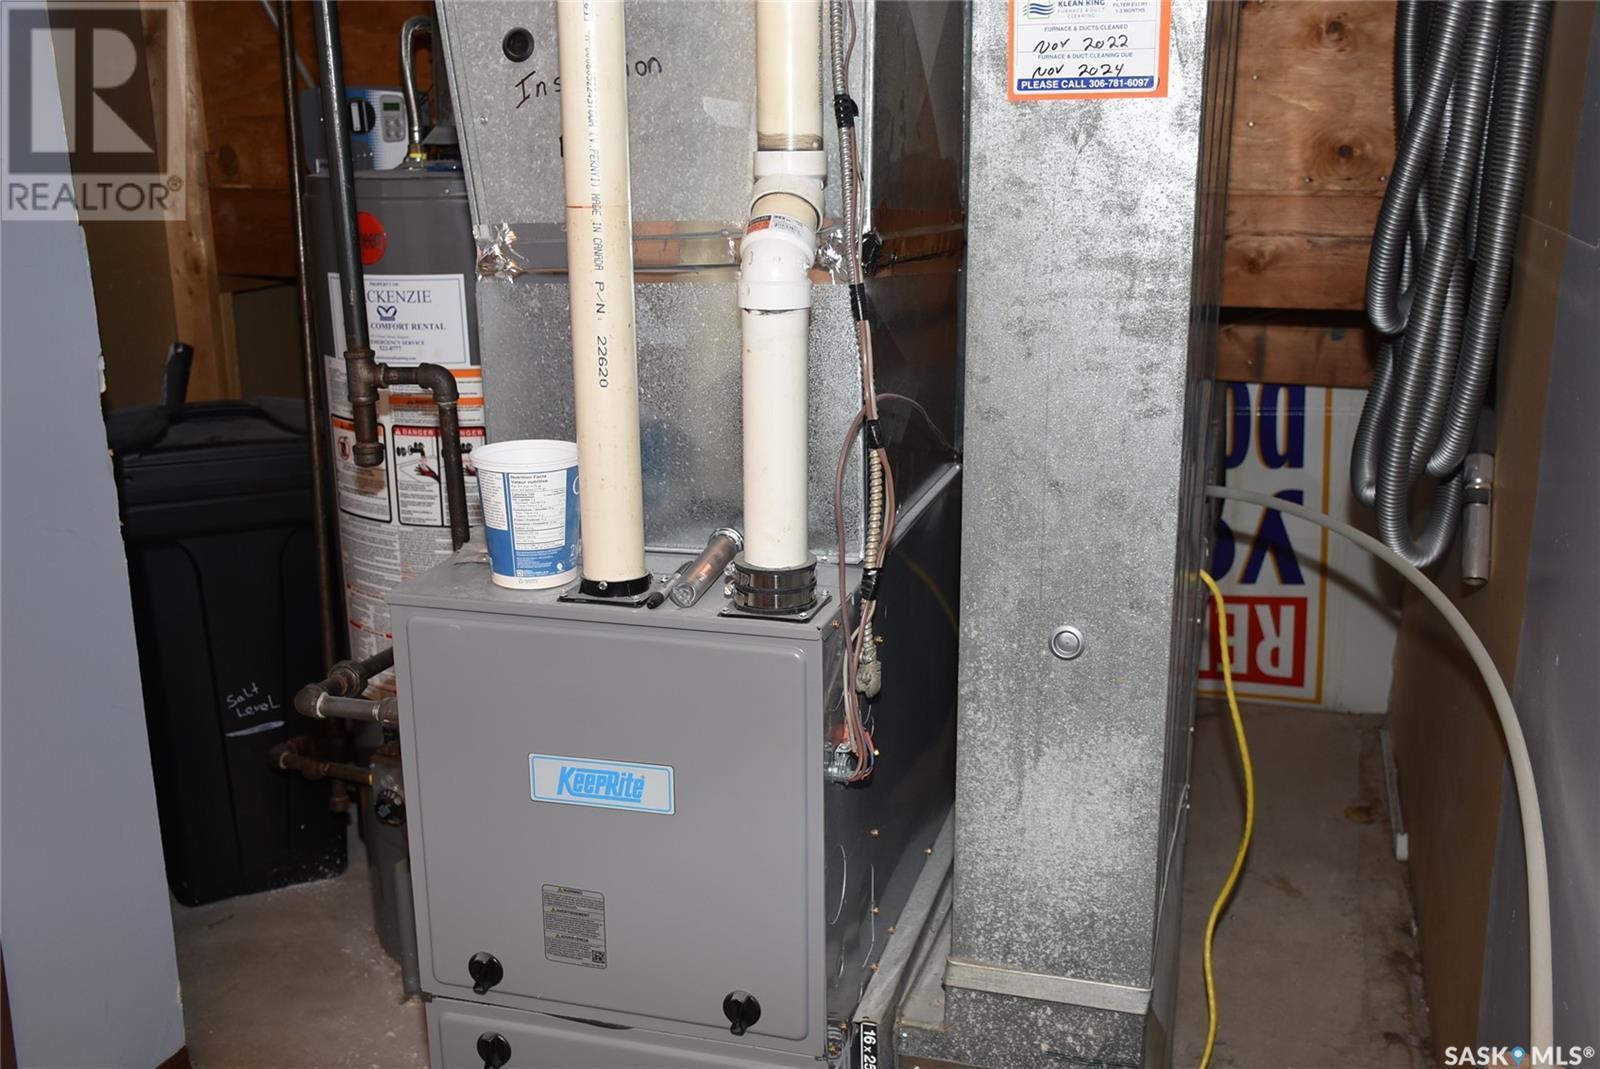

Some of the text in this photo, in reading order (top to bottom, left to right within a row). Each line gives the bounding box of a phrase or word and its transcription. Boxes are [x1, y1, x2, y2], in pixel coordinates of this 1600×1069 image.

[1083, 34, 1128, 51] 2022
[1078, 63, 1124, 77] 2024
[1021, 78, 1149, 89] PLEASE CALL 306-781-6097
[591, 193, 602, 216] MADE
[592, 222, 602, 233] IN
[592, 237, 604, 271] CANADA
[411, 322, 445, 330] RENTAL
[596, 335, 608, 388] 22620
[401, 427, 434, 436] DANGER
